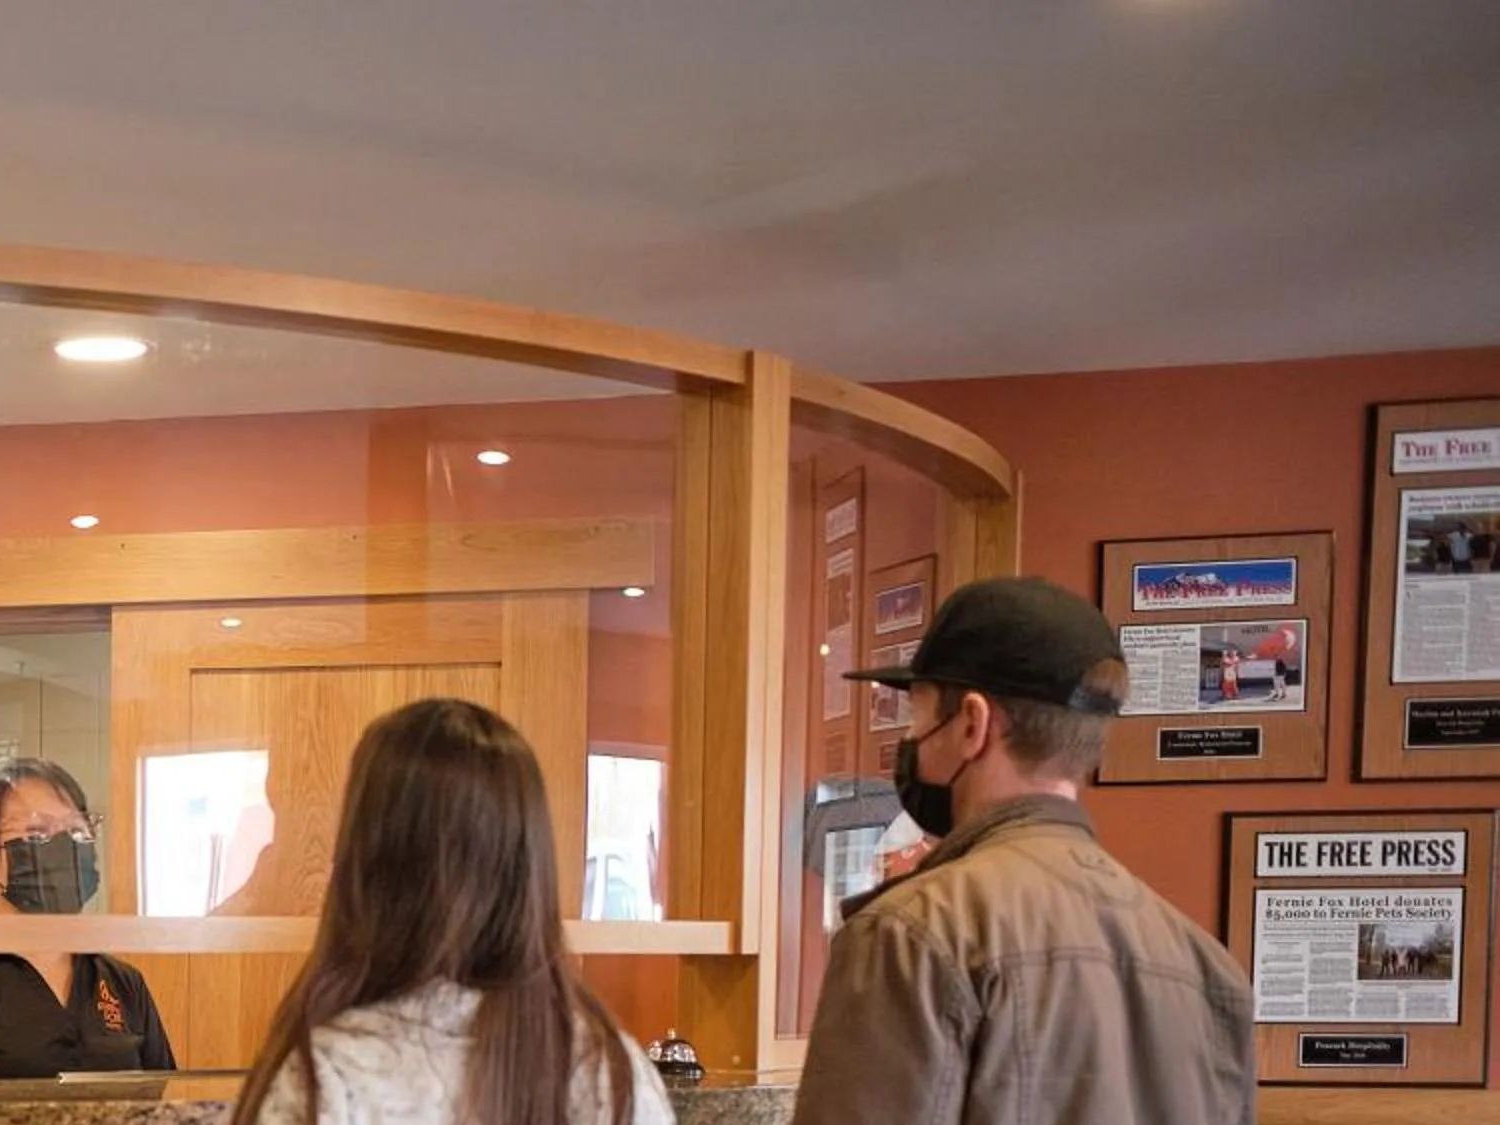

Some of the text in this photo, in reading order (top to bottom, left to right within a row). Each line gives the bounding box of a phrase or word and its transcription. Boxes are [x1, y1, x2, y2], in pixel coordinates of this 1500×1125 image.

[1235, 577, 1292, 597] PRESS
[1264, 839, 1456, 868] THE FREE PRESS
[1267, 895, 1453, 908] Fernie Fox Hotel donates
[1265, 907, 1452, 921] $5,000 to Fernie Pets Society
